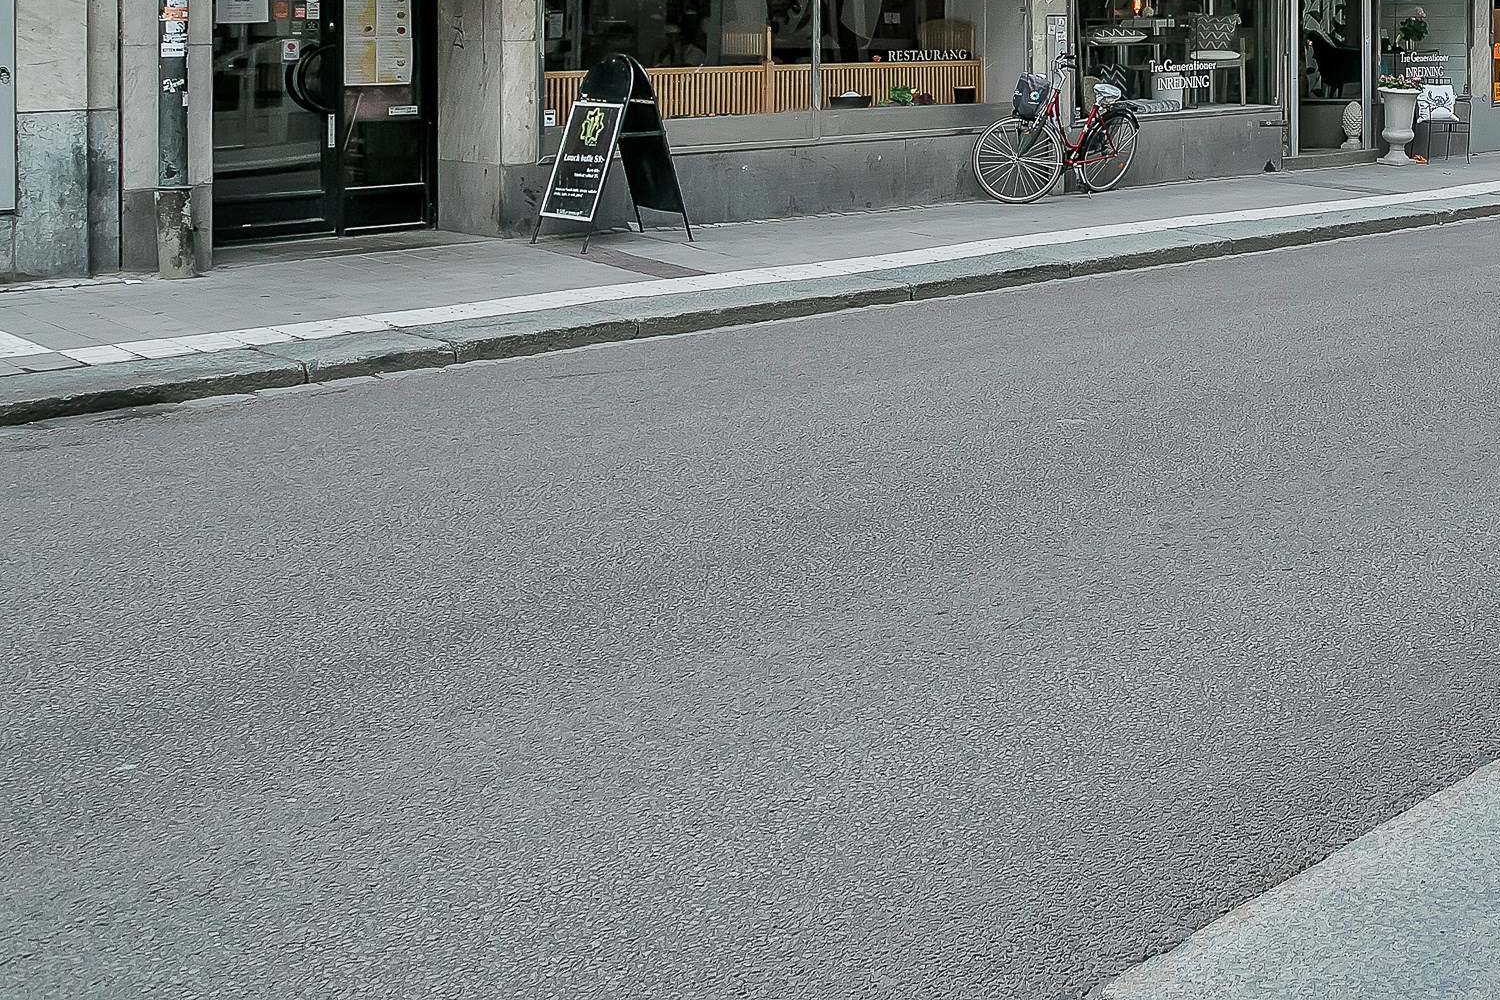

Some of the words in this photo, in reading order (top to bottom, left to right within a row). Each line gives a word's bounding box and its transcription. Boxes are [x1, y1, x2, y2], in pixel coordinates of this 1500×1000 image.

[888, 49, 967, 62] RESTAURANG
[1149, 60, 1163, 72] Tre
[1164, 58, 1217, 72] Generationer
[1157, 74, 1210, 91] INREDNING
